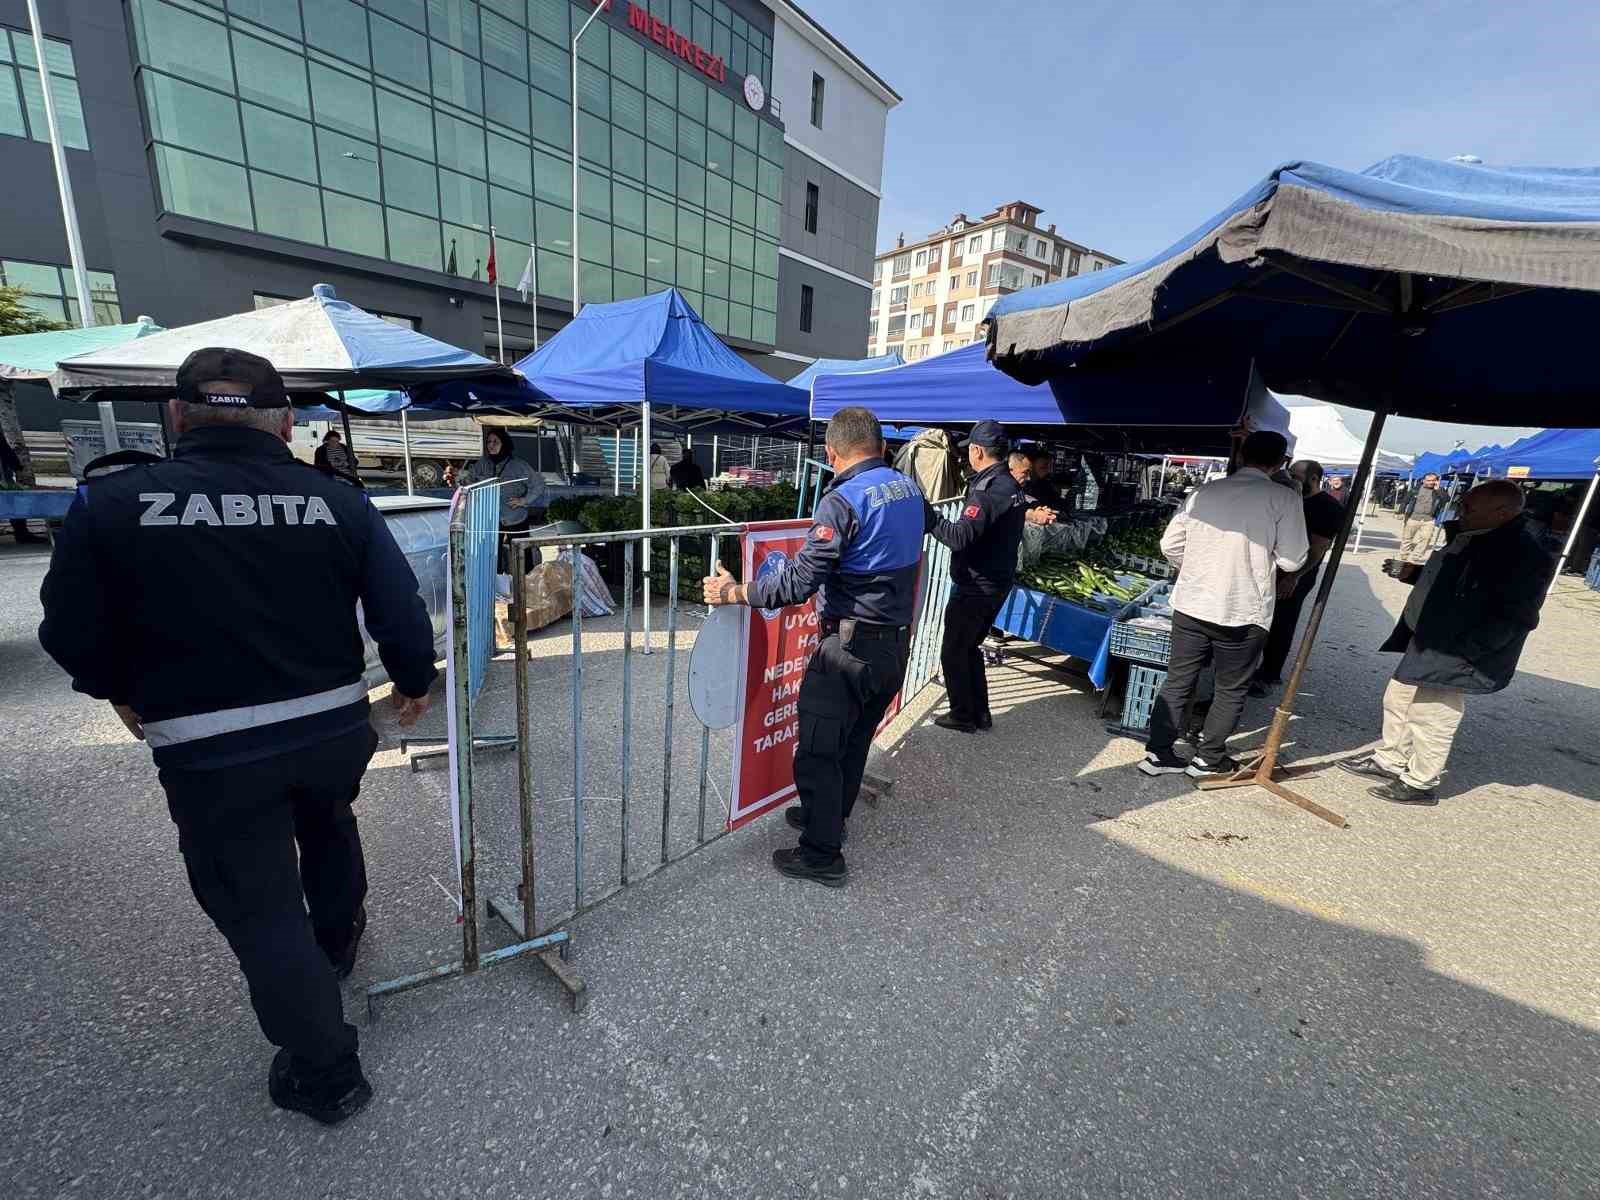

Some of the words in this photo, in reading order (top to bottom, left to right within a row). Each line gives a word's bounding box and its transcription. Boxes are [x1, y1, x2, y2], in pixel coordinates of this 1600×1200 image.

[628, 3, 725, 83] MERKEZİ
[210, 395, 248, 405] ZABITA
[139, 492, 337, 526] ZABITA
[784, 609, 817, 630] UYG
[797, 626, 819, 649] HA
[764, 653, 813, 684] NEDEN
[771, 678, 802, 703] HAK
[763, 700, 798, 727] GERE
[753, 720, 799, 753] TARAF
